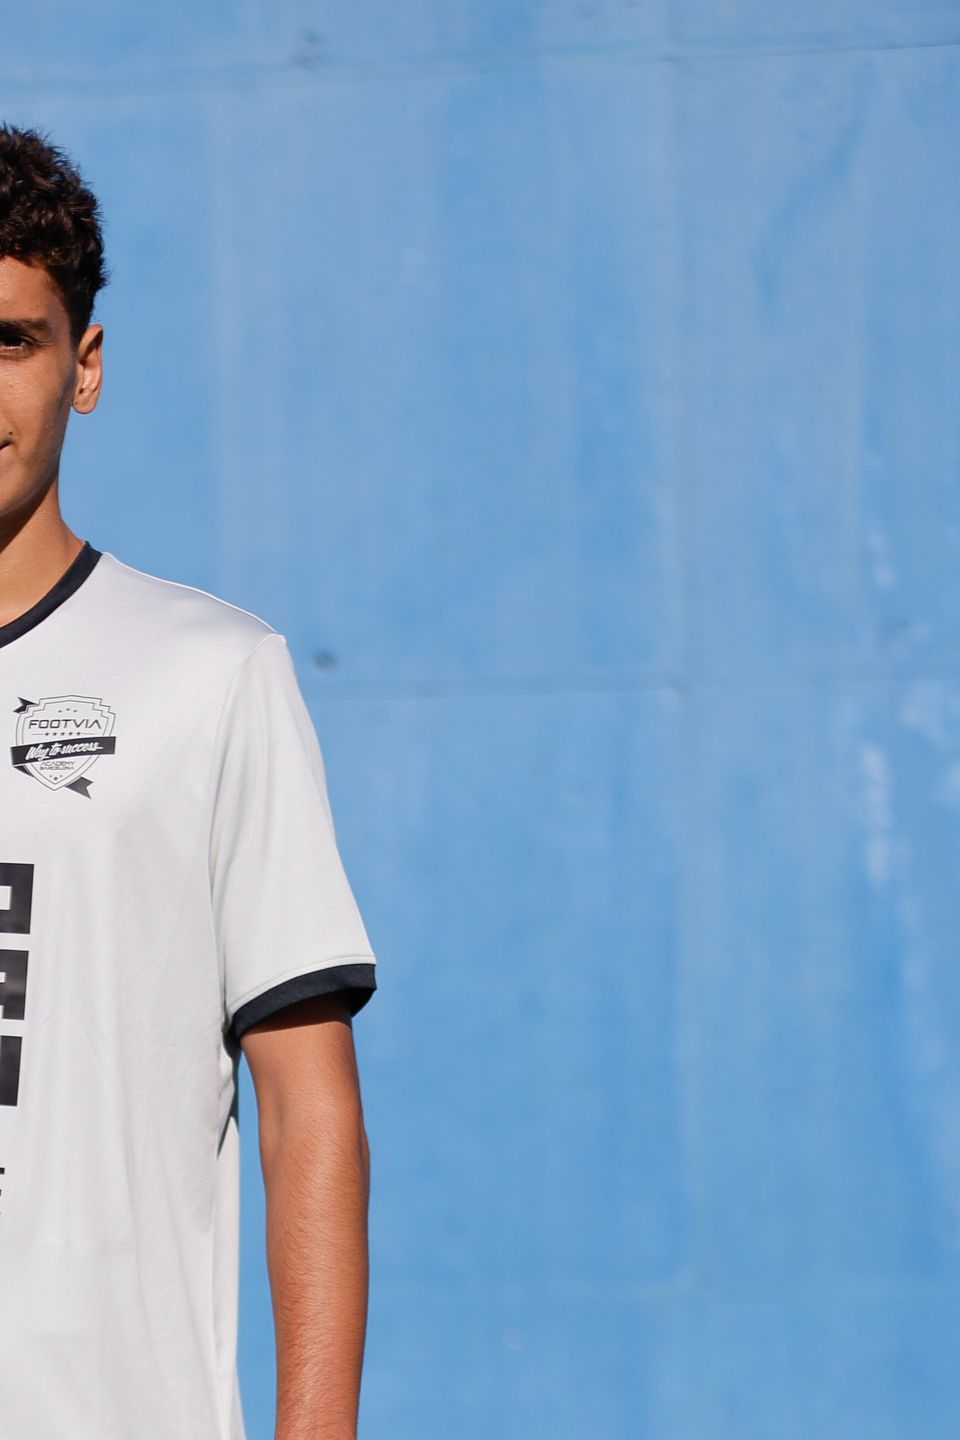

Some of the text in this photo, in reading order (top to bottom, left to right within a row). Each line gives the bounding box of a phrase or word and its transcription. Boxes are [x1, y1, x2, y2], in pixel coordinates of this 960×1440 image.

[28, 719, 102, 729] FOOTVIA
[25, 741, 104, 761] Way to success
